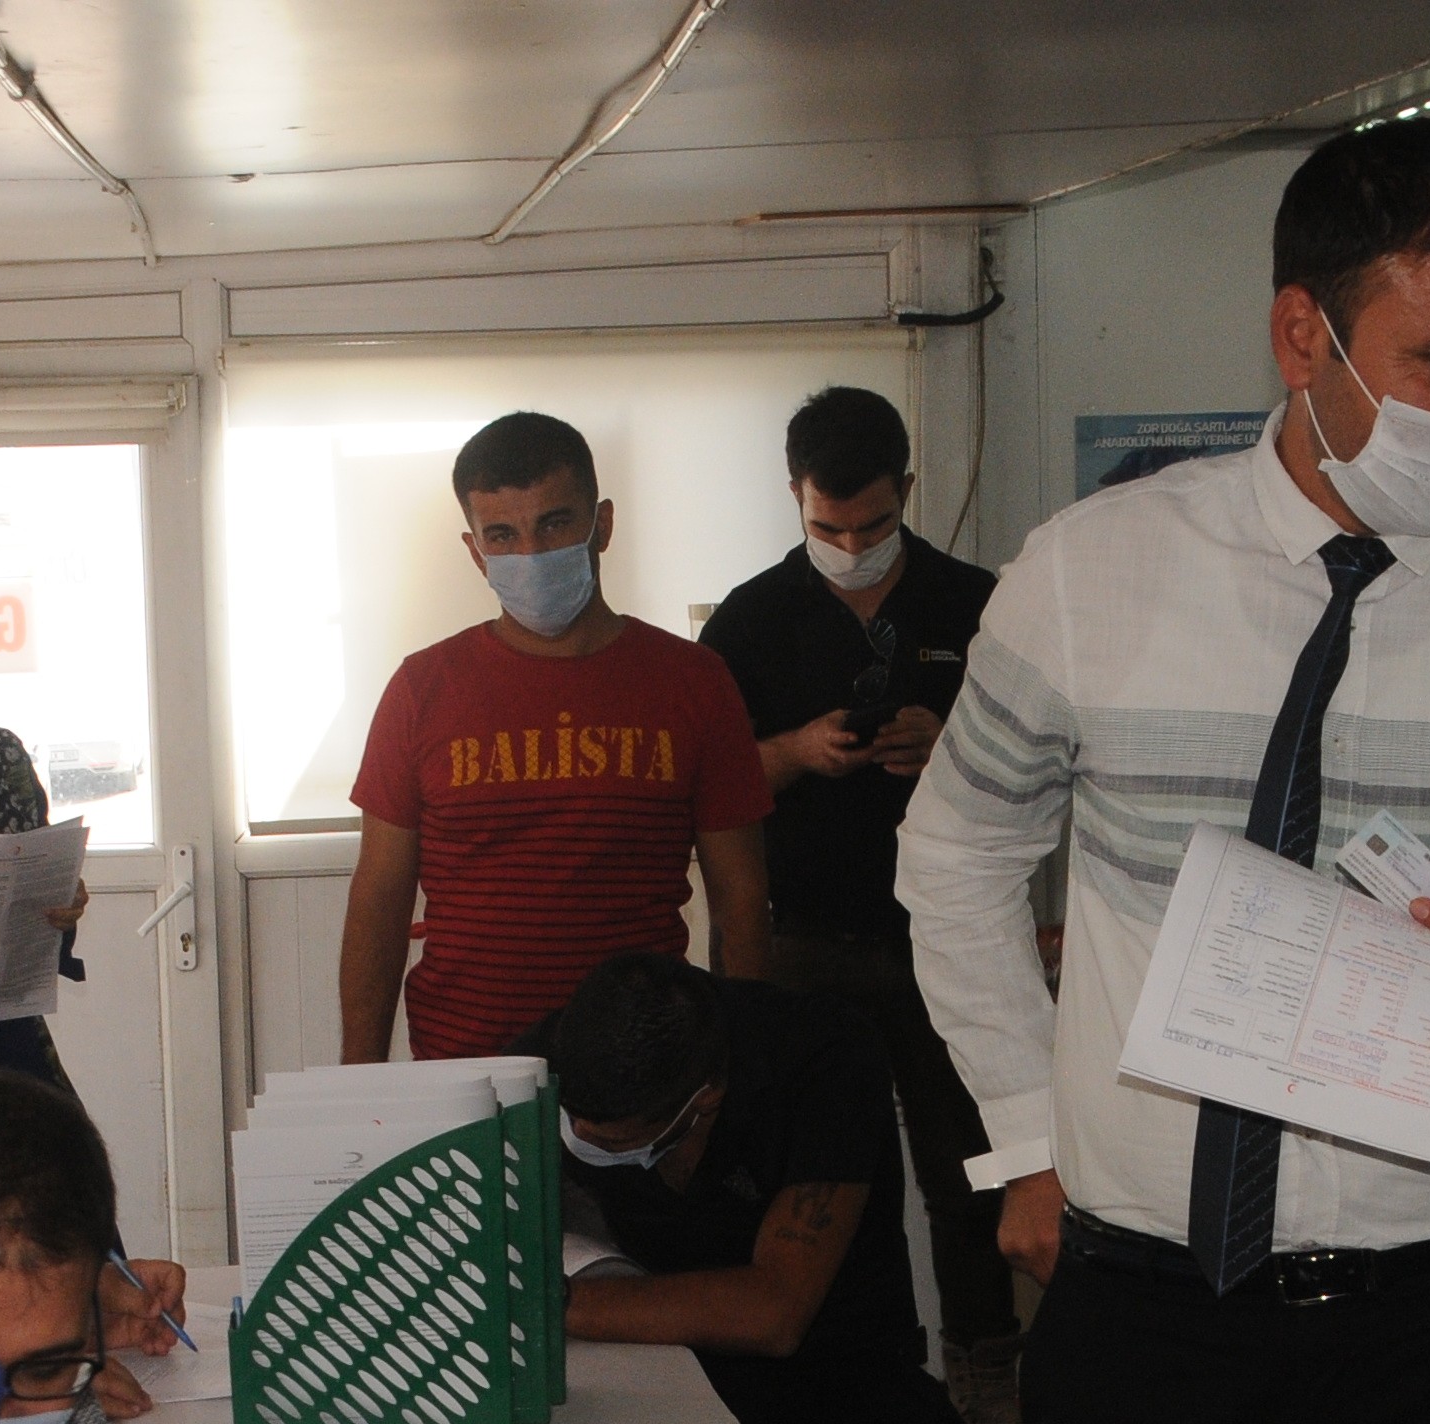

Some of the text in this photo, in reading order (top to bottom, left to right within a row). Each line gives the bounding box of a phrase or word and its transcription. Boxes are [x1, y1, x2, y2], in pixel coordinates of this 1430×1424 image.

[1137, 423, 1159, 434] ZOR
[1161, 419, 1192, 433] DOĞA
[1094, 435, 1175, 448] ANADOLU'NUN
[1178, 434, 1200, 446] HER
[1203, 431, 1243, 444] YERİNE
[450, 711, 674, 787] BALİSTA
